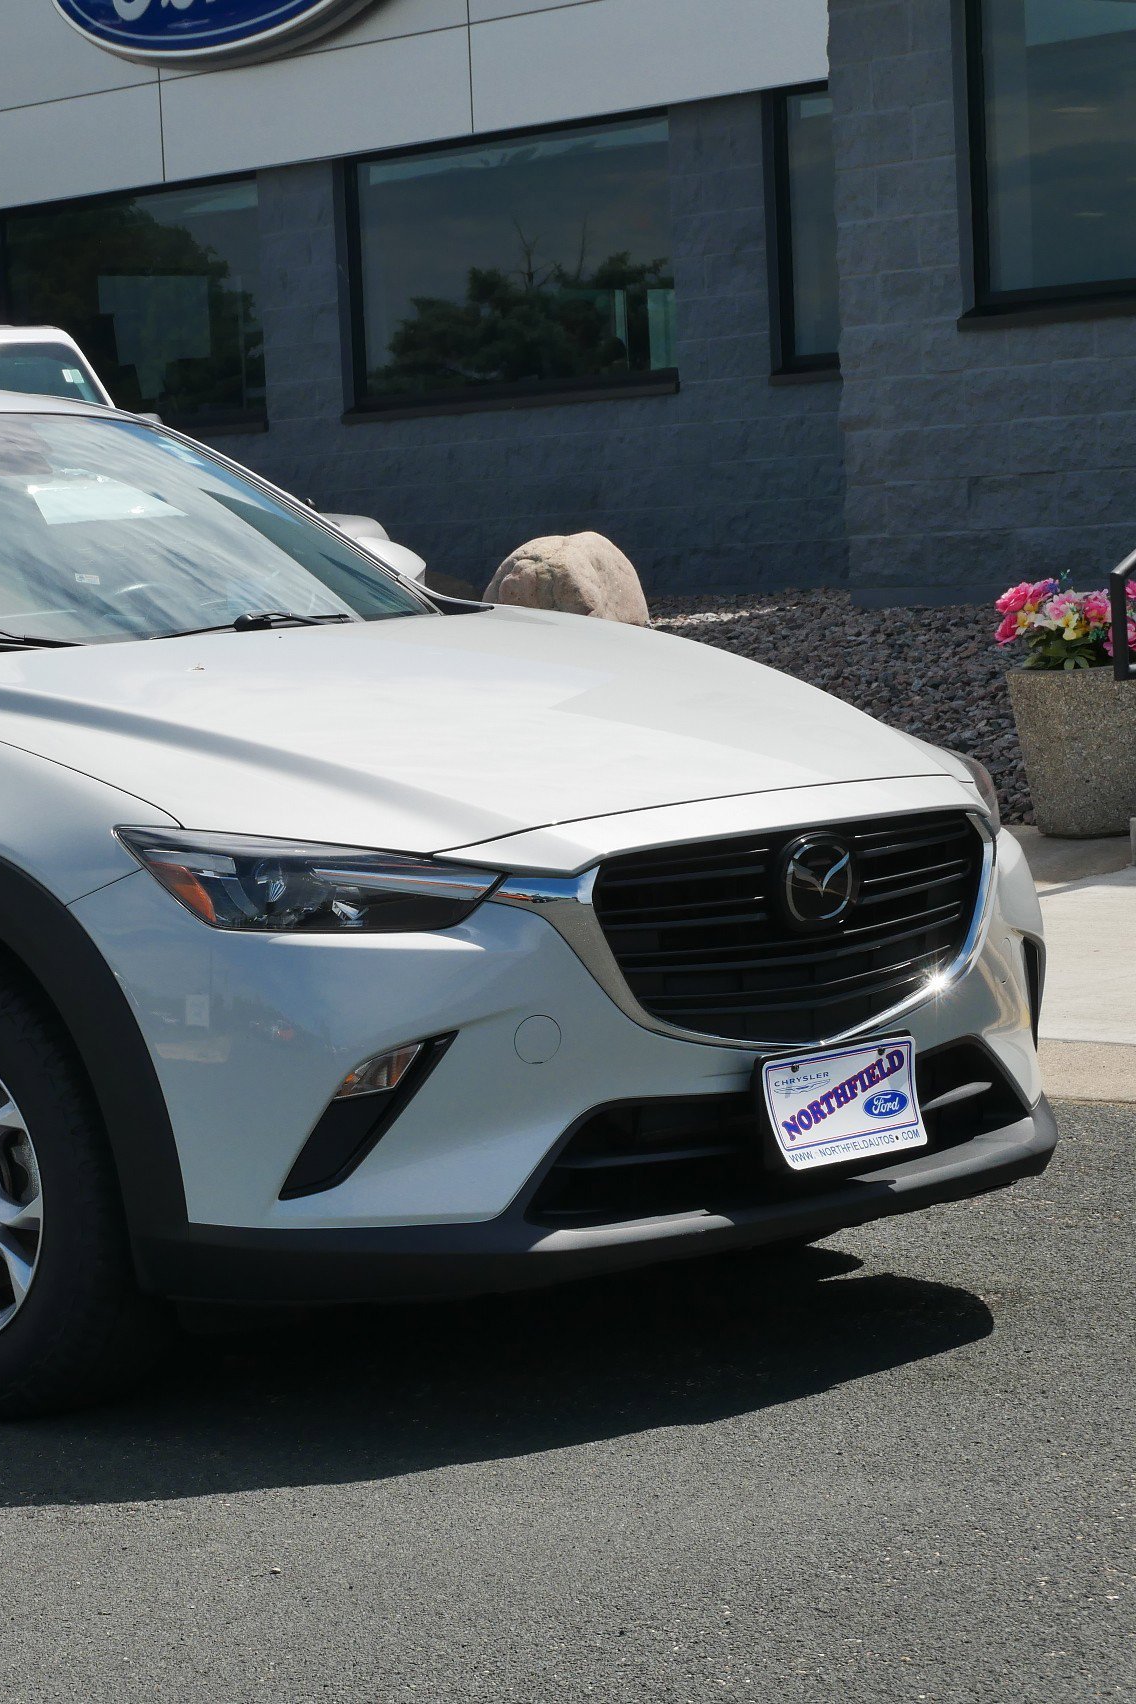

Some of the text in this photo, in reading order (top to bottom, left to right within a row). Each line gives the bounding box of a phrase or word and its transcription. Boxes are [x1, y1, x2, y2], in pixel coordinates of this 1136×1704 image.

[774, 1071, 829, 1087] CHRYSLER
[781, 1049, 905, 1141] NORTHFIELD
[872, 1095, 900, 1114] Ford
